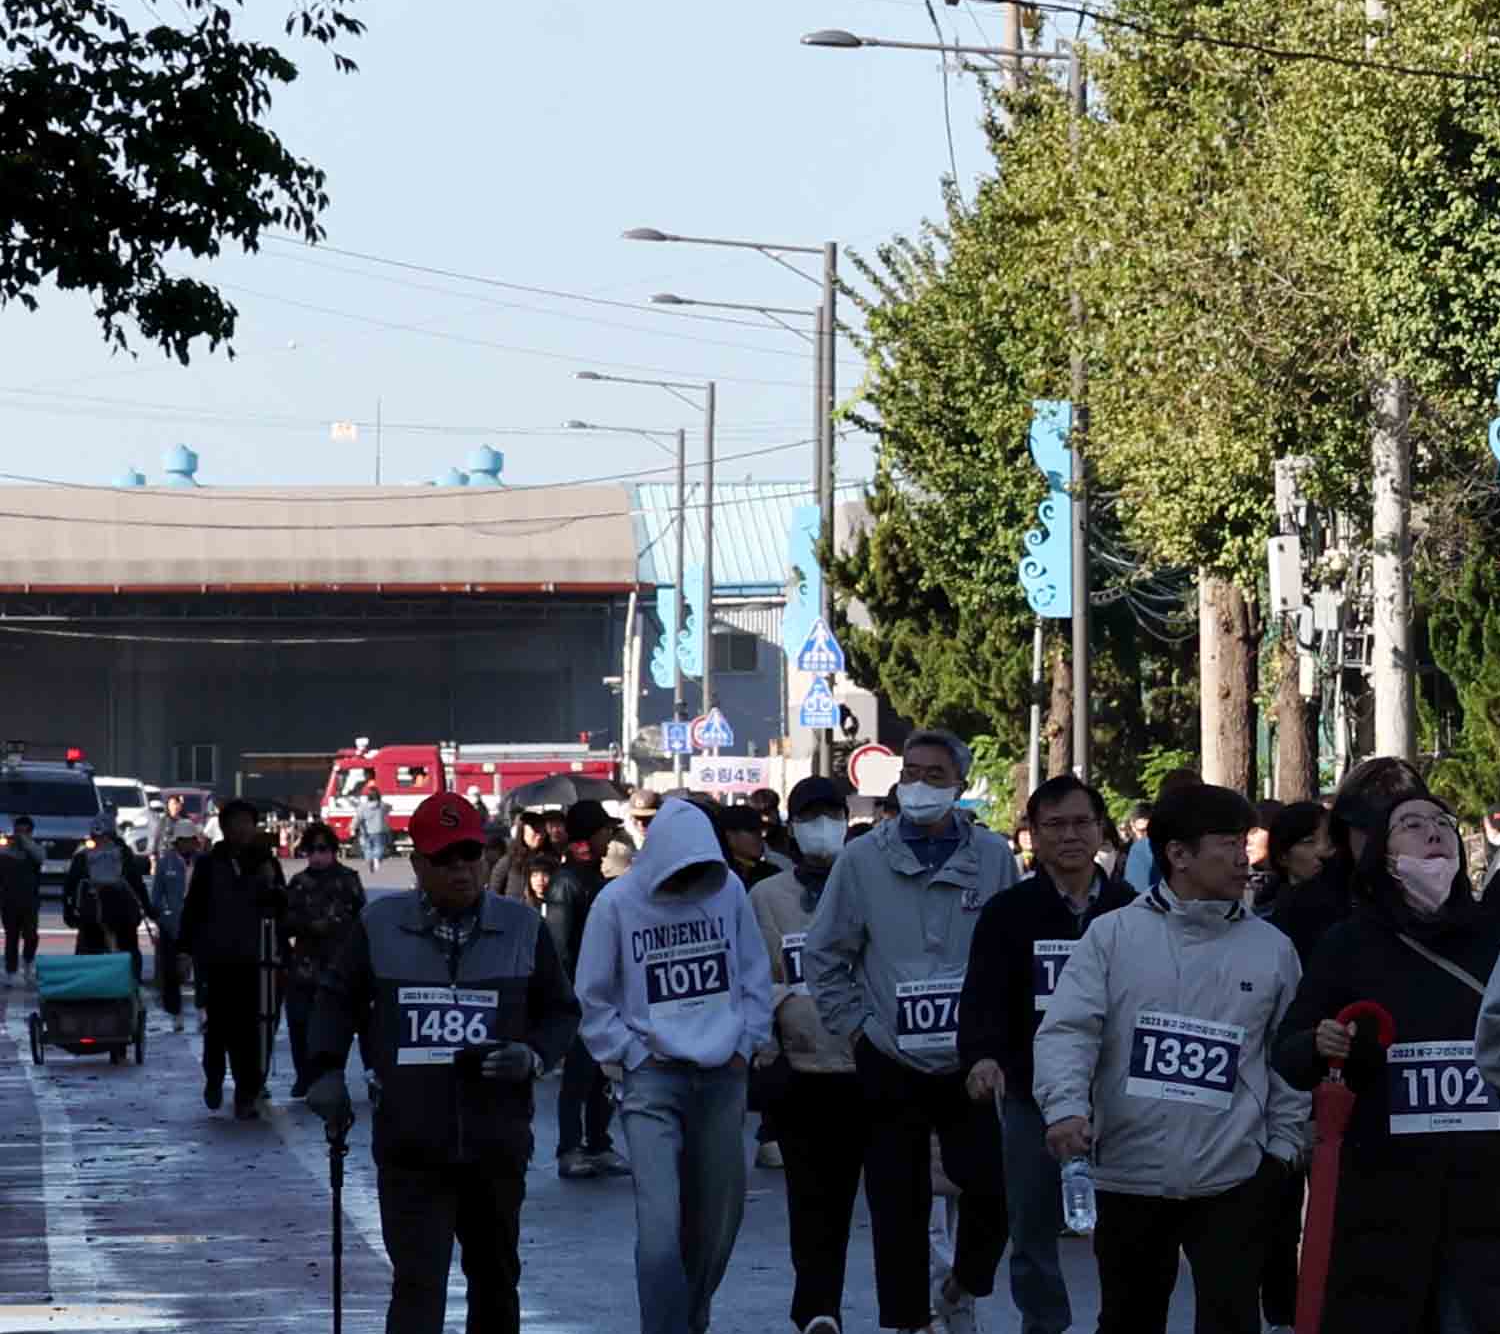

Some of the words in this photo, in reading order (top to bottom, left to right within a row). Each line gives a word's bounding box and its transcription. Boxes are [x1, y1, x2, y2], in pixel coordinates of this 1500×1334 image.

[654, 959, 721, 996] 1012
[407, 1009, 488, 1045] 1486
[903, 997, 961, 1030] 107
[1143, 1035, 1229, 1084] 1332
[1402, 1066, 1489, 1106] 1102
